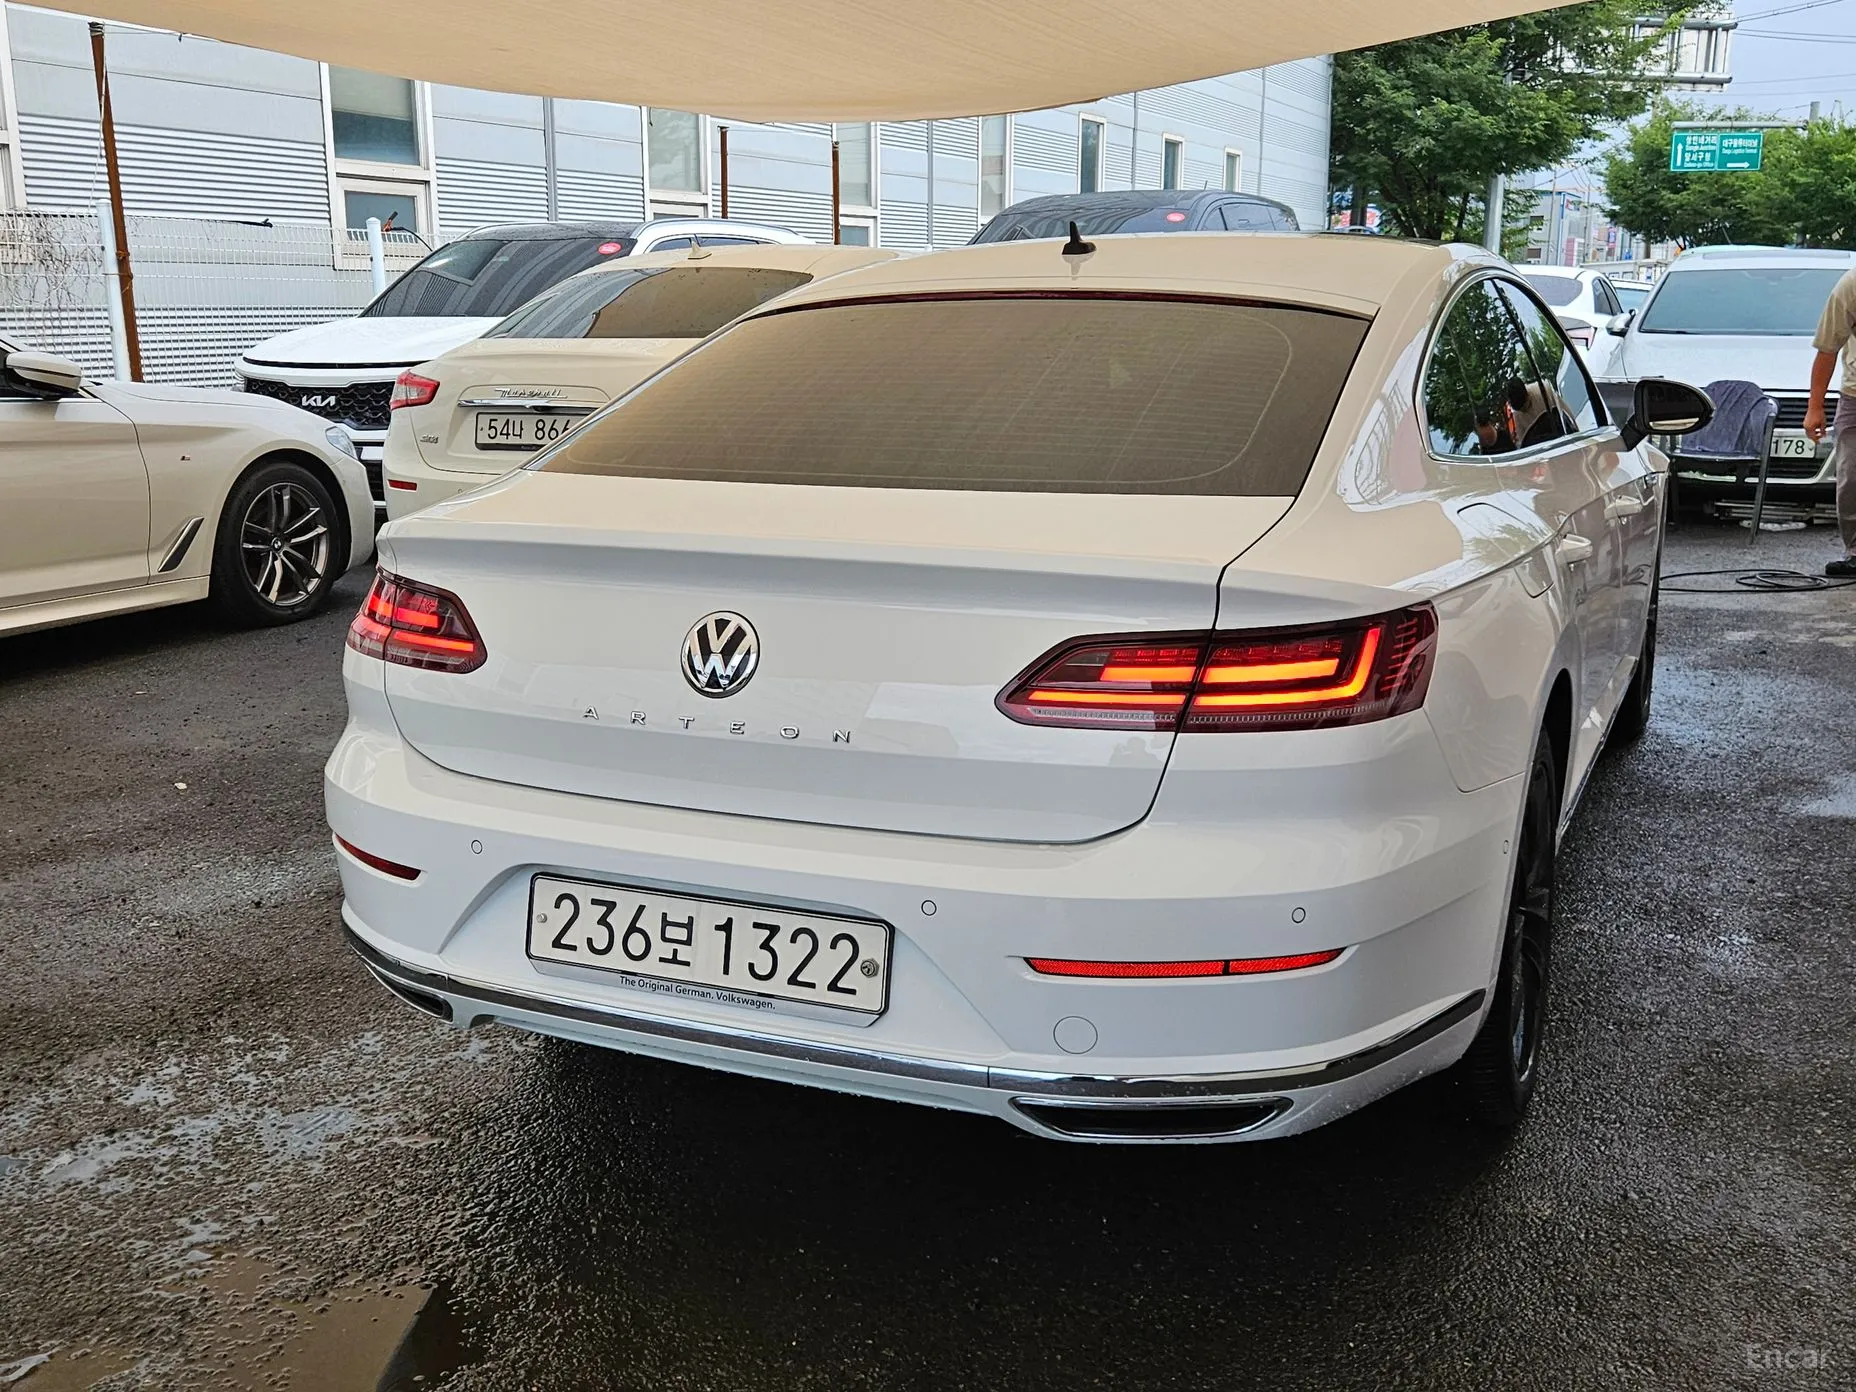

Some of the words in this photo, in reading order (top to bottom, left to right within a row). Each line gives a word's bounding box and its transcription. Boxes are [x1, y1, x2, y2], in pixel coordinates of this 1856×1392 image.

[487, 418, 524, 440] 54나
[582, 705, 851, 744] ARTEON
[551, 892, 694, 968] 236보
[713, 916, 860, 996] 1322
[619, 975, 636, 987] The
[637, 978, 673, 993] Original
